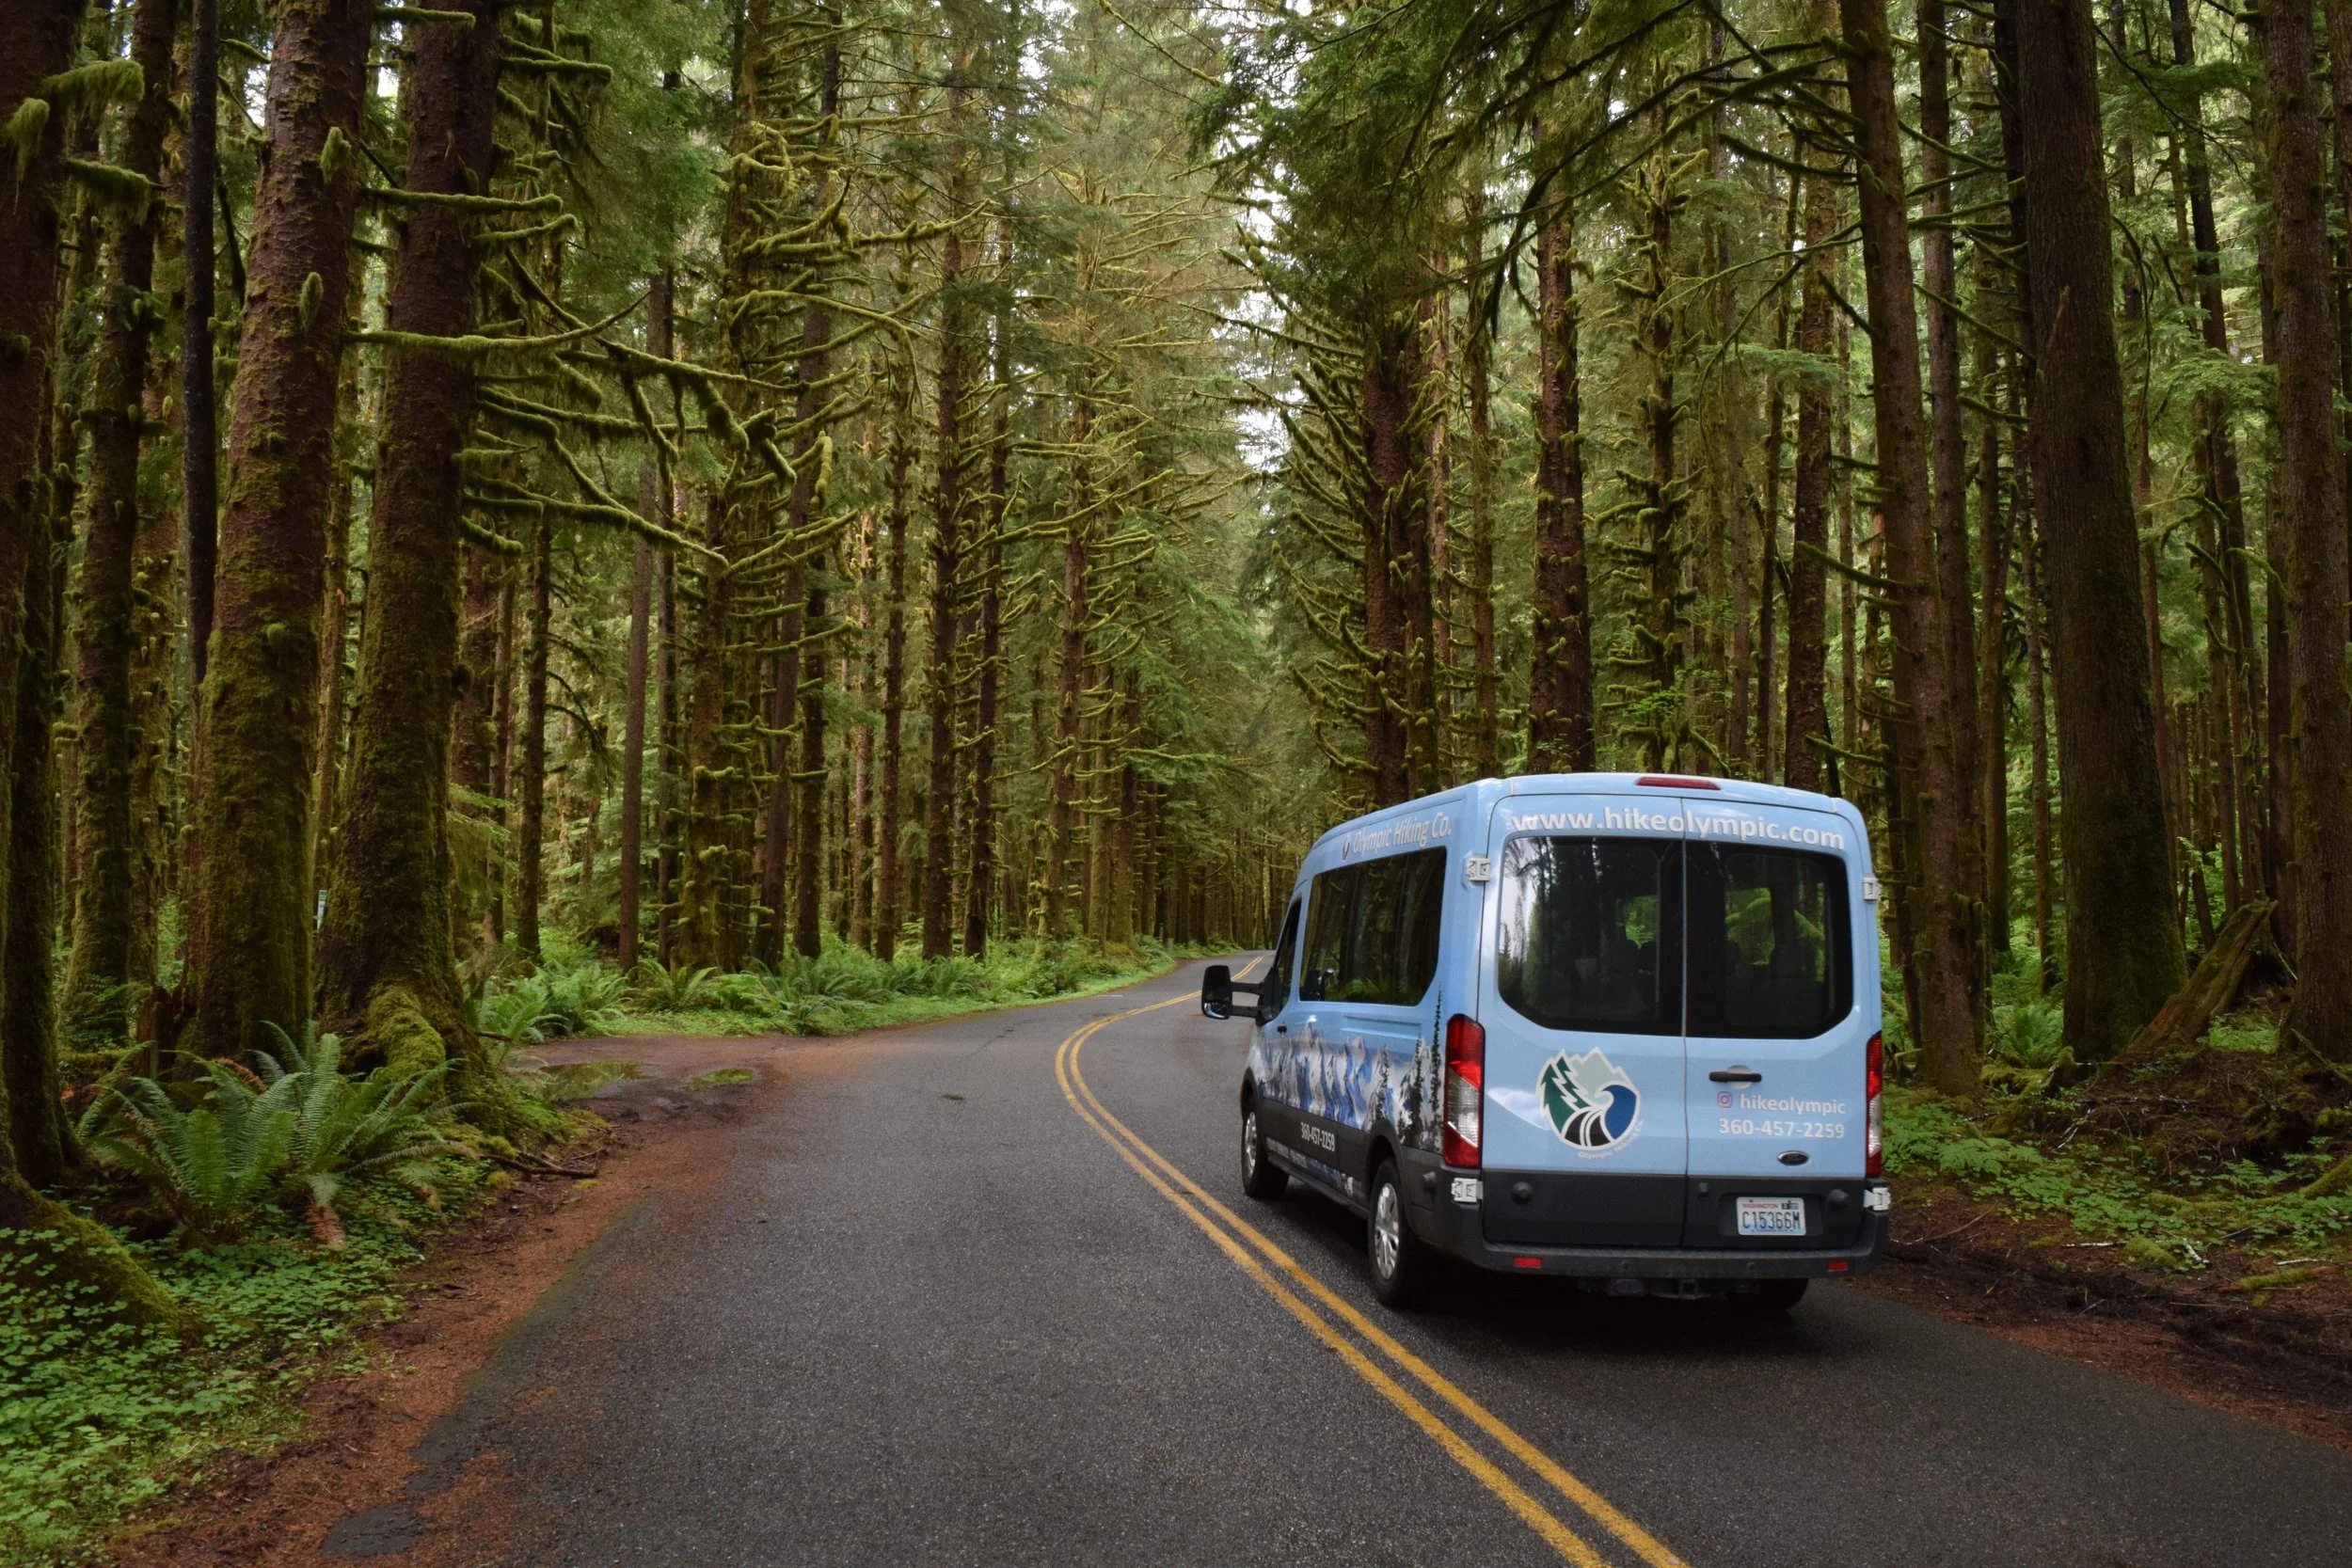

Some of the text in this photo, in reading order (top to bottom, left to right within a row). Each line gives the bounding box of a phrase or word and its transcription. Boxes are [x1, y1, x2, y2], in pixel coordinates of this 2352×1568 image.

[1353, 811, 1452, 858] Olympic Hiking Co.
[1511, 805, 1844, 850] www.hikeolympic.com
[1740, 1094, 1846, 1116] hikeolympic
[1300, 1121, 1335, 1152] 360-457-2259
[1719, 1118, 1845, 1139] 360-457-2259
[1742, 1211, 1801, 1229] C15366M
